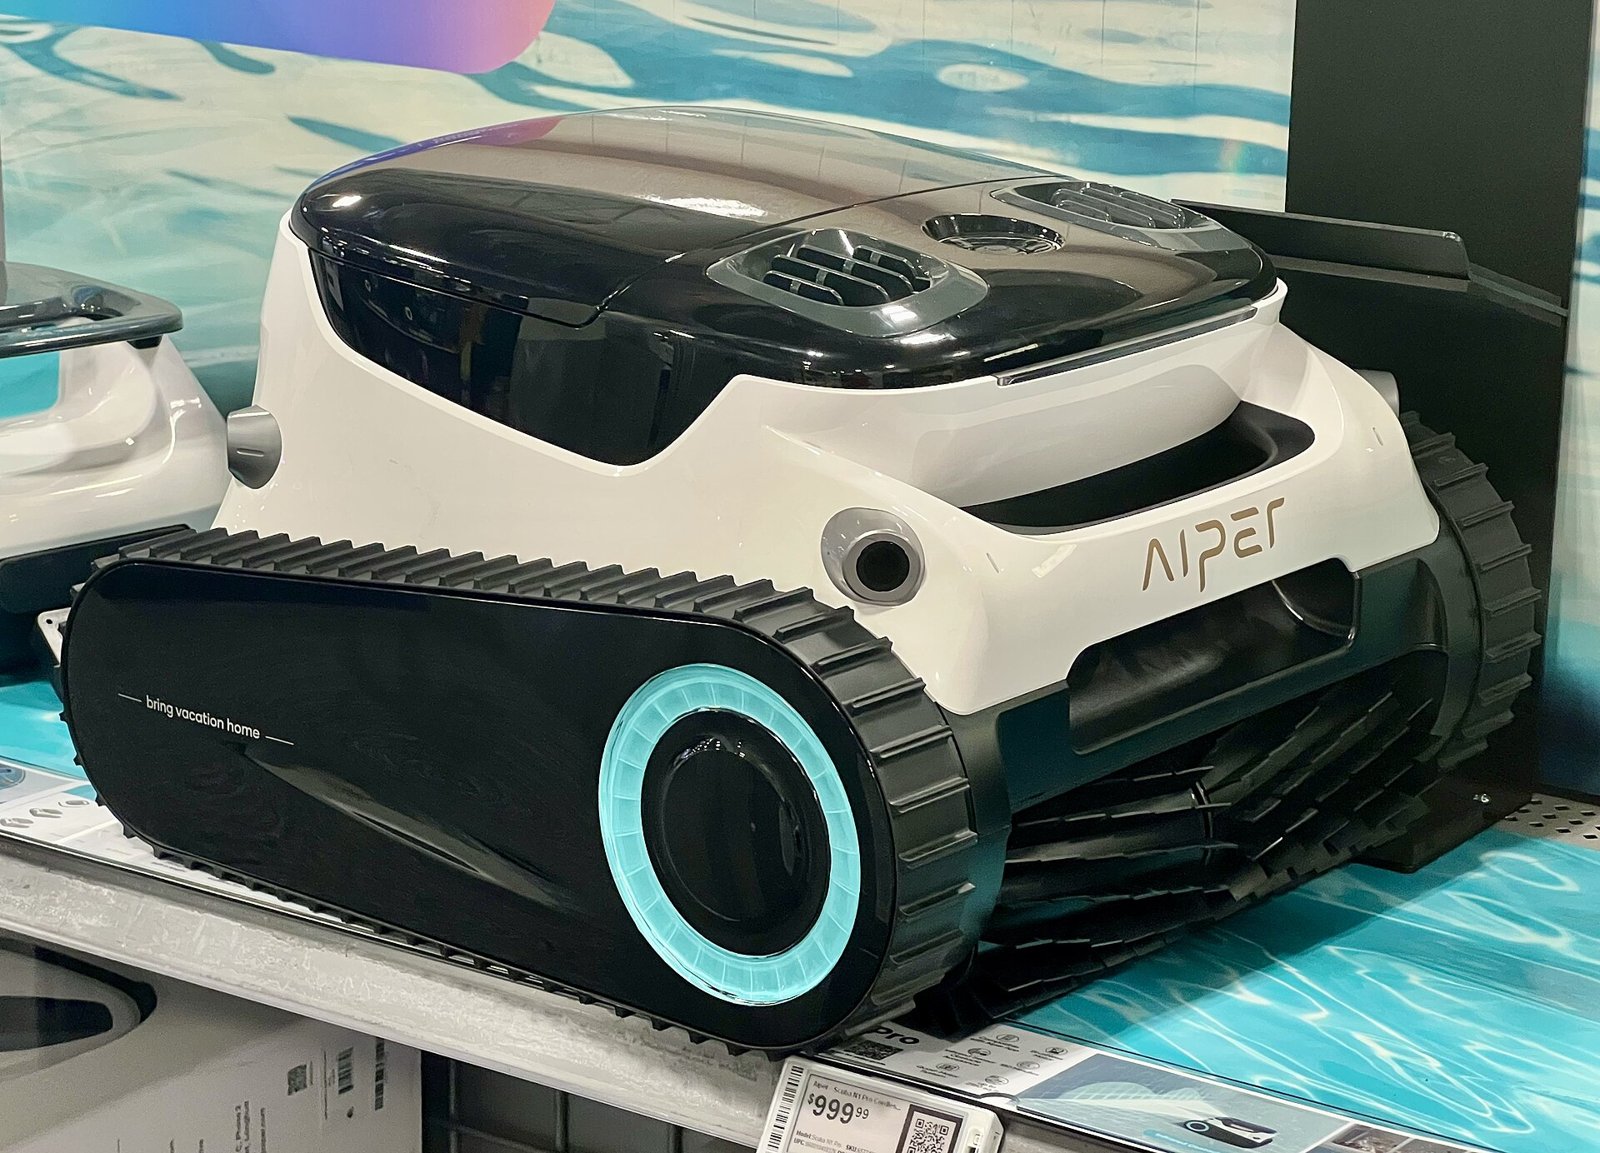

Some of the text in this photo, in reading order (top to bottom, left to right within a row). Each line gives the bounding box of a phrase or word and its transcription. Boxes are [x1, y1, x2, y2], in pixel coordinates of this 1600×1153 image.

[146, 695, 260, 739] bring vacation home
